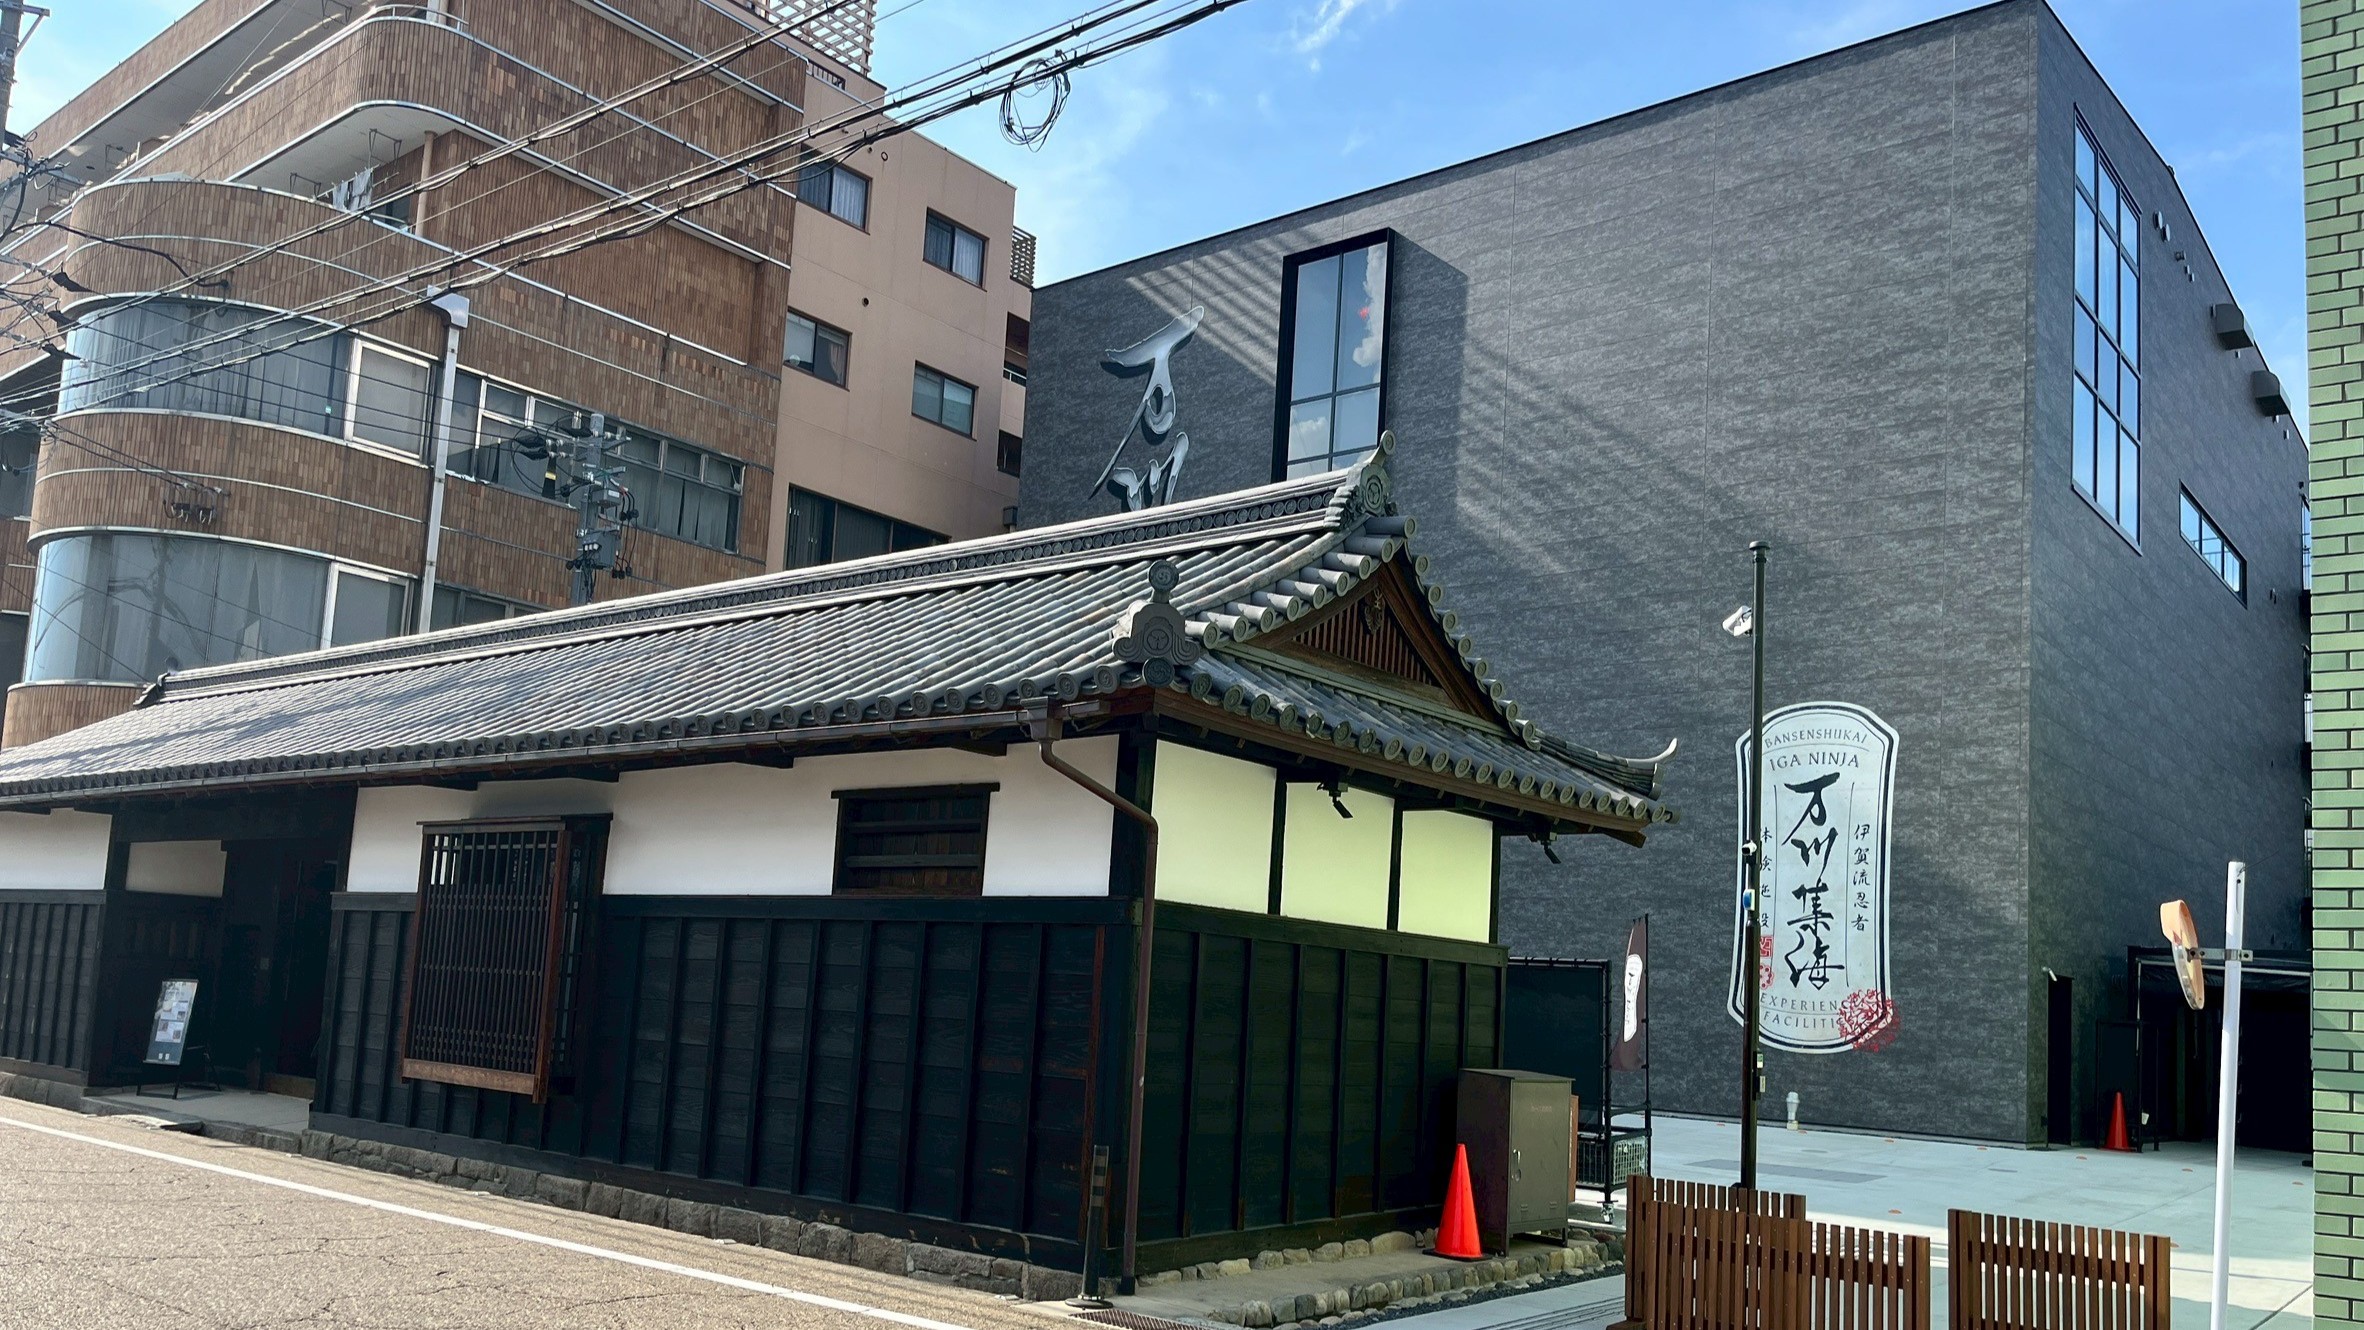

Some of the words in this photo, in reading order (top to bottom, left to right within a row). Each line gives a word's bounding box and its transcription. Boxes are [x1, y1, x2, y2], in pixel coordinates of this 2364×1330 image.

[1764, 728, 1868, 749] BANSENSHUKAI
[1769, 753, 1801, 771] IGA
[1808, 751, 1860, 768] NINJA
[1781, 772, 1845, 990] 万川集海
[1851, 823, 1871, 932] 伊賀流忍者
[1760, 991, 1853, 1012] EXPERIENC
